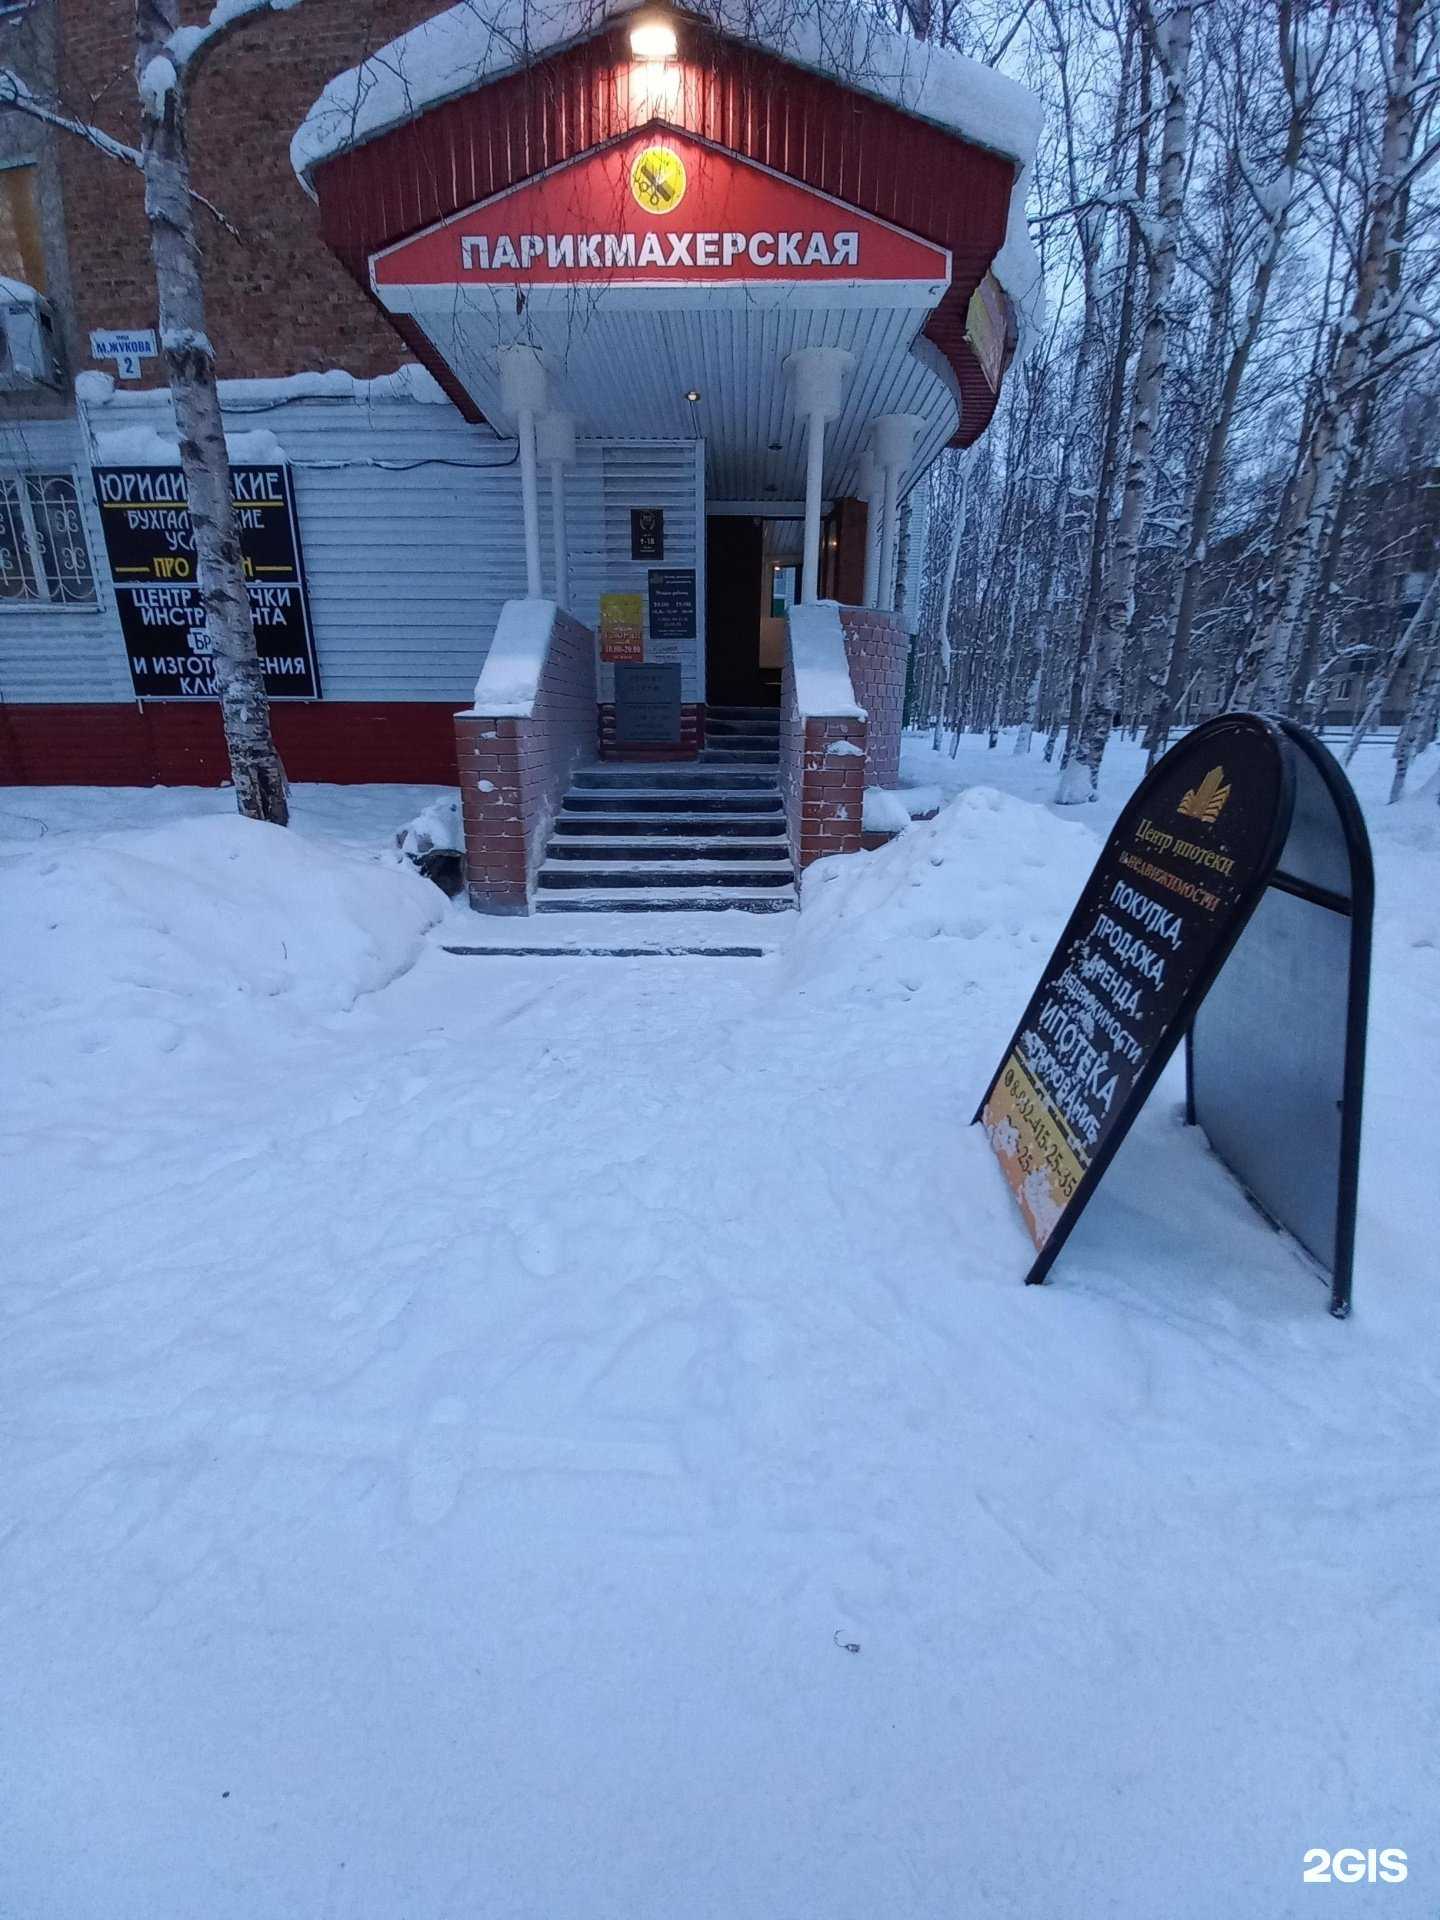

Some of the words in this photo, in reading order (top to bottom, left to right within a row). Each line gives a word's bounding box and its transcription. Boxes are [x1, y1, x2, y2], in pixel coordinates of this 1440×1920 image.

[461, 231, 859, 270] ПАРИКМАХЕРСКАЯ
[124, 356, 134, 374] 2
[100, 472, 283, 502] ЮРИДИКИЕ
[132, 589, 192, 609] ЦЕНТР
[141, 607, 288, 627] ИНСТРНТА
[133, 656, 149, 675] И
[1135, 819, 1175, 855] Центр
[1171, 839, 1236, 878] ипотеки
[1109, 879, 1184, 950] ПОКУПКА,
[1092, 913, 1166, 992] ПРОДАЖА,
[1039, 1001, 1120, 1113] ИПОТЕКА
